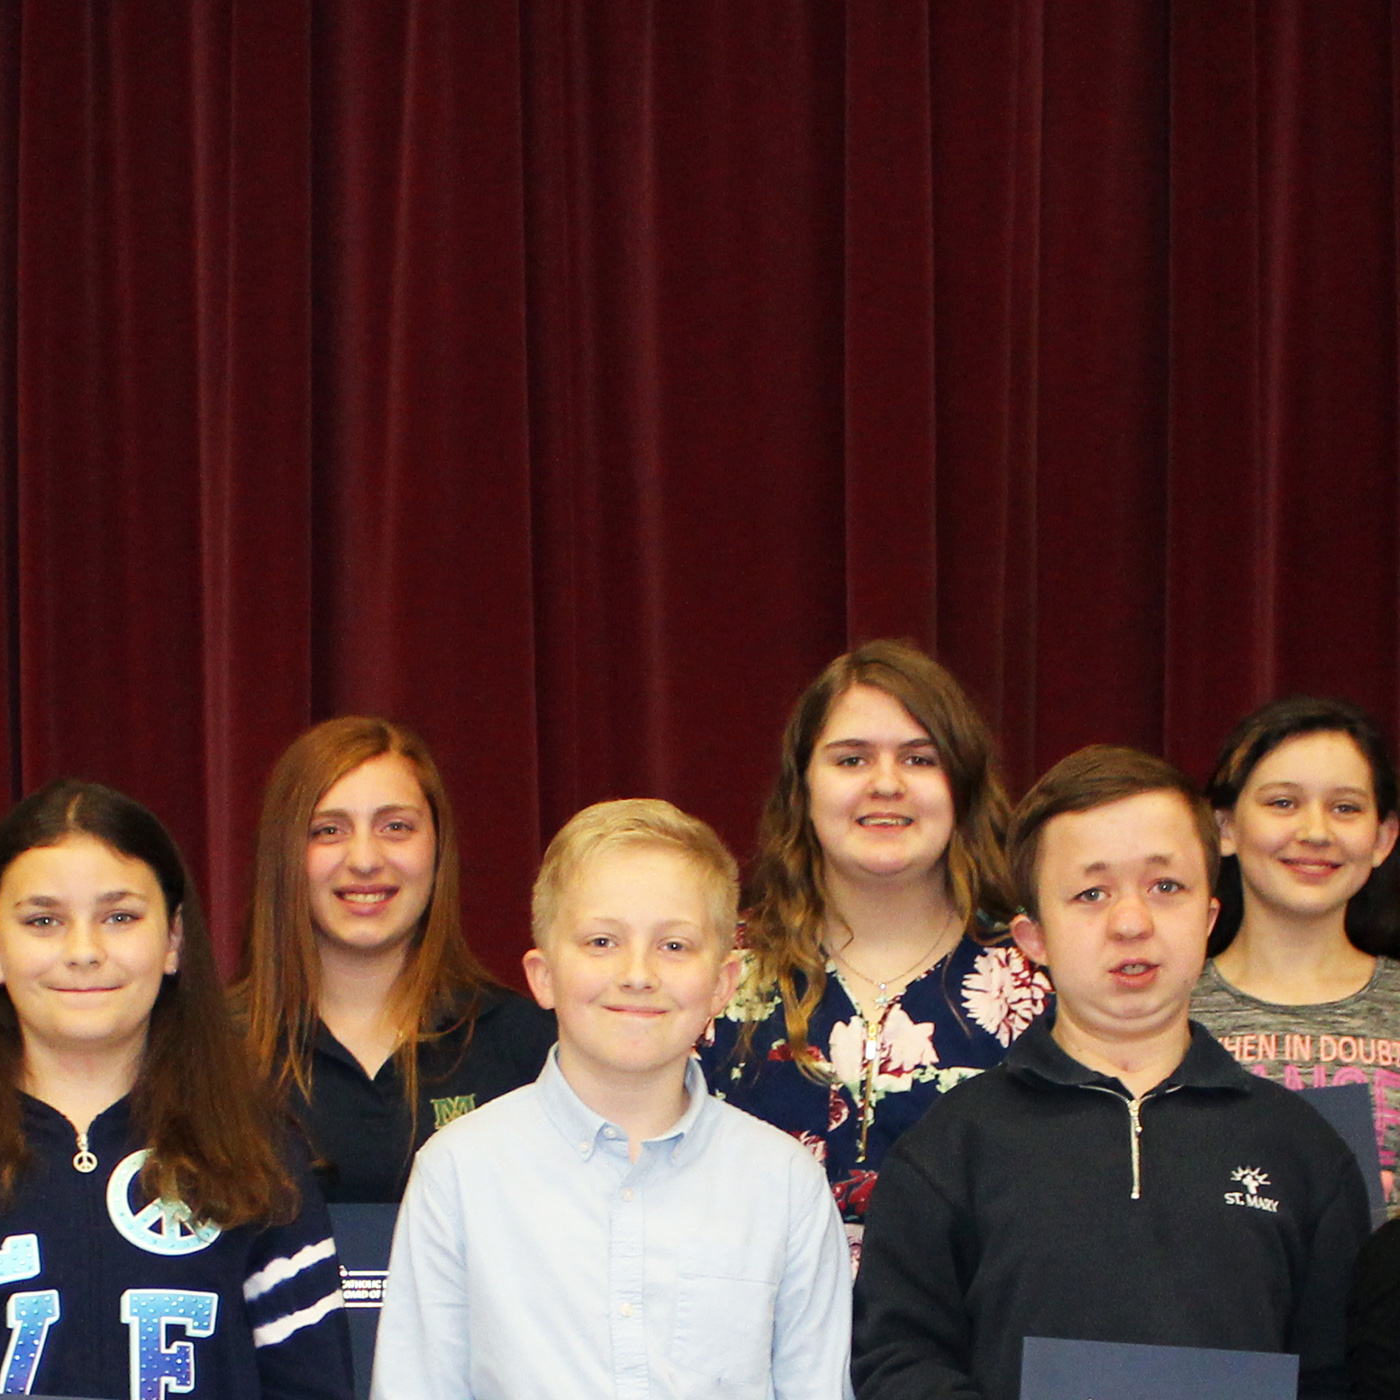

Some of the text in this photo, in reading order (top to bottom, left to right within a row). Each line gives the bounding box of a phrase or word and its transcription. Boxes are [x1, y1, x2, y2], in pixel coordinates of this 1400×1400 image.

[1217, 1034, 1277, 1062] HEN
[1284, 1034, 1313, 1062] IN
[1223, 1191, 1245, 1206] ST.
